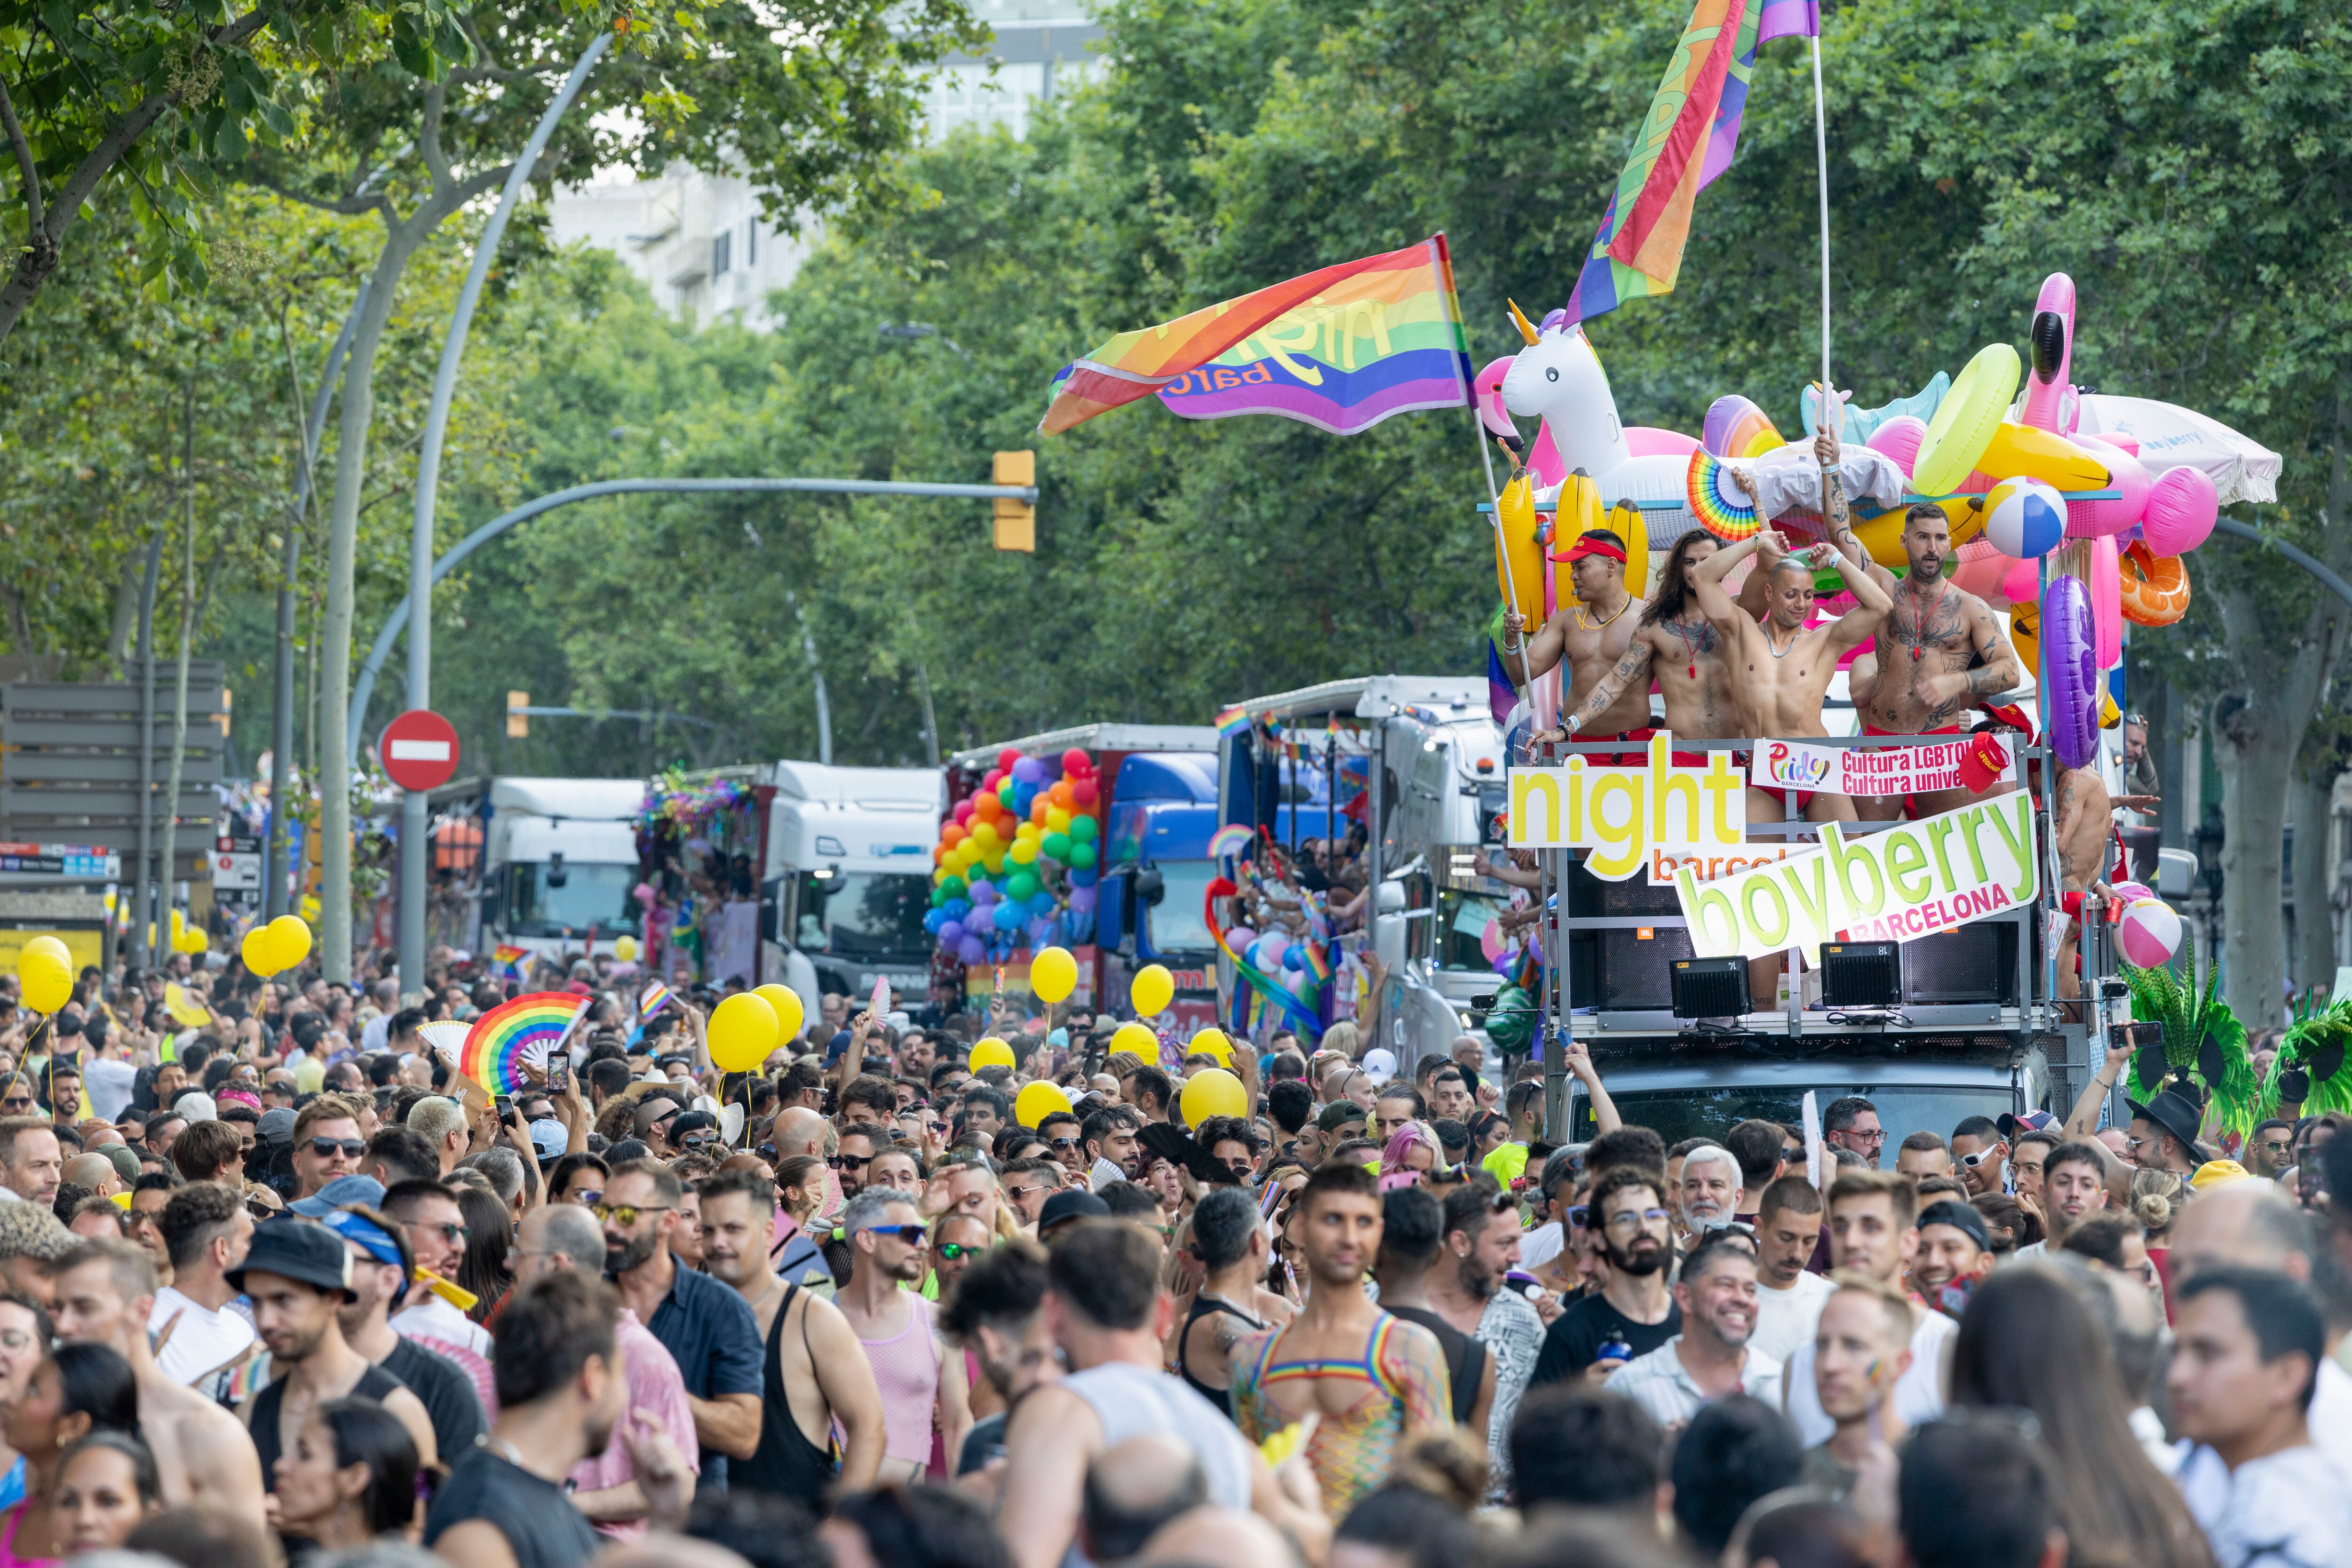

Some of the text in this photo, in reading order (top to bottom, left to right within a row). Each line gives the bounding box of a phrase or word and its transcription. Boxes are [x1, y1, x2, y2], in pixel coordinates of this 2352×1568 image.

[2141, 431, 2203, 450] boyberry
[1842, 750, 1909, 773] Cultura
[1978, 750, 2001, 772] LIFEGUARD
[1842, 771, 1912, 796] Cultura
[1513, 736, 1740, 876] night
[1677, 794, 2034, 963] boyberry
[1852, 883, 2011, 941] BARCELONA
